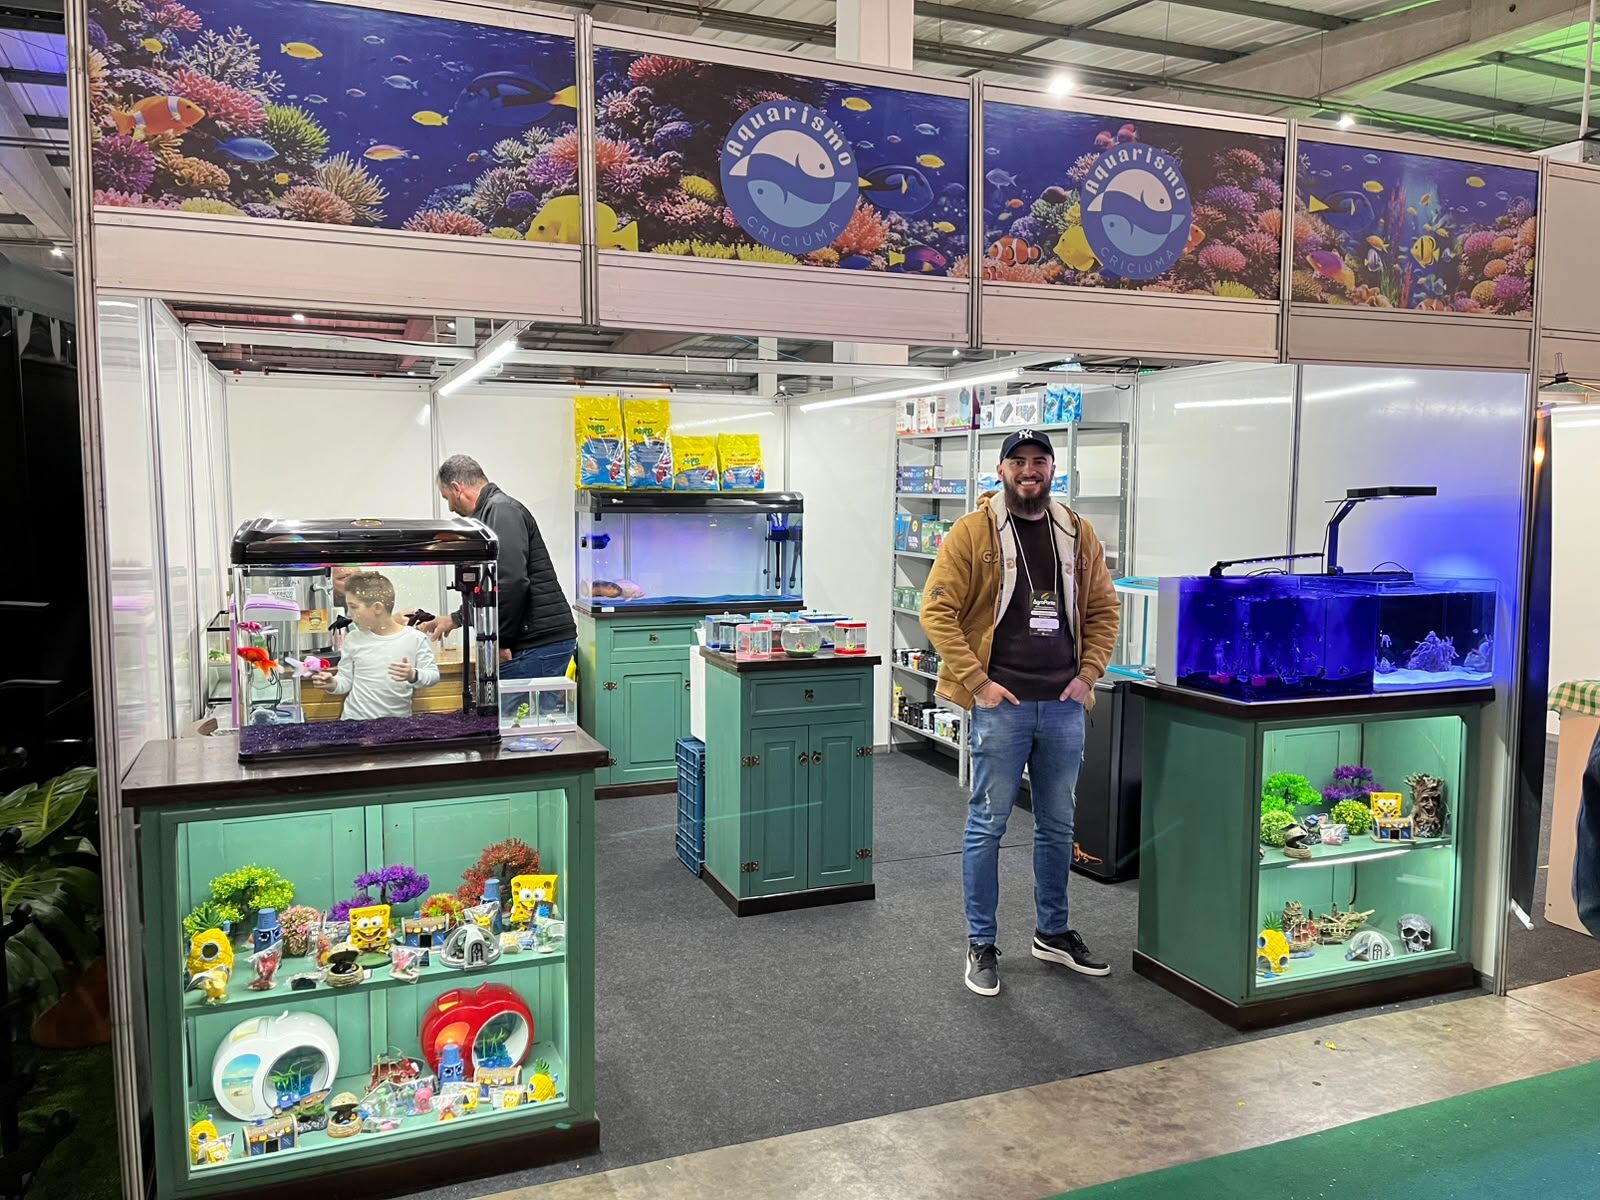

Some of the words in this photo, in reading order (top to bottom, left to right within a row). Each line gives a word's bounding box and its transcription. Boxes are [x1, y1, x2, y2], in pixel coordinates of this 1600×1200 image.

[726, 106, 851, 166] Aquarismo
[1085, 147, 1186, 200] Aquarismo
[747, 215, 840, 247] CRICIÚMA
[1101, 247, 1175, 273] CRICIÚMA
